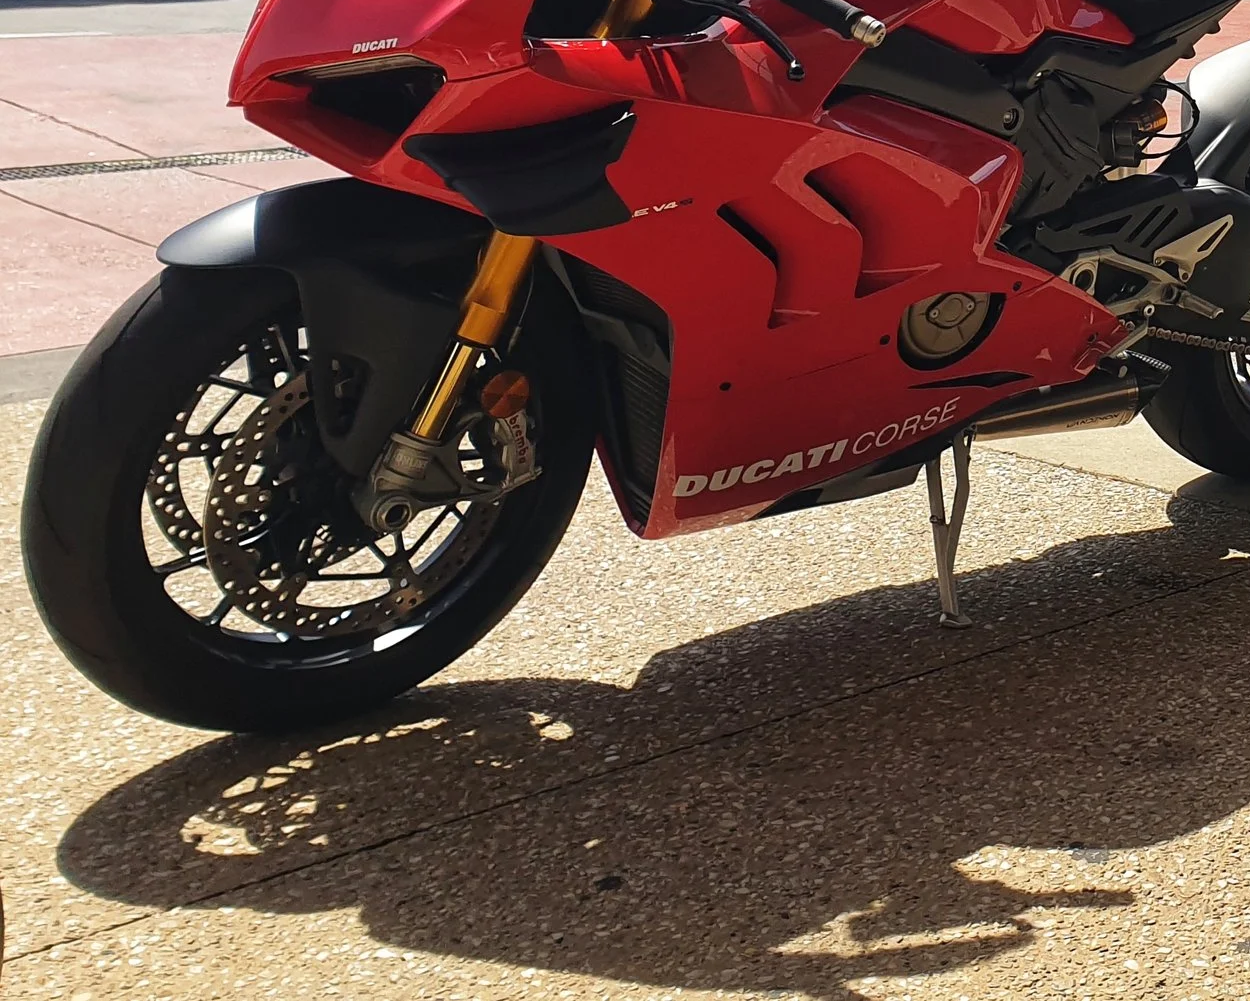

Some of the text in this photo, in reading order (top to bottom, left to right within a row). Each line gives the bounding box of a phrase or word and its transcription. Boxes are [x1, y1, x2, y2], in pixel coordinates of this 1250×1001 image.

[352, 37, 398, 55] DUCATI
[508, 414, 529, 464] brembo
[672, 396, 960, 497] DUCATI CORSE
